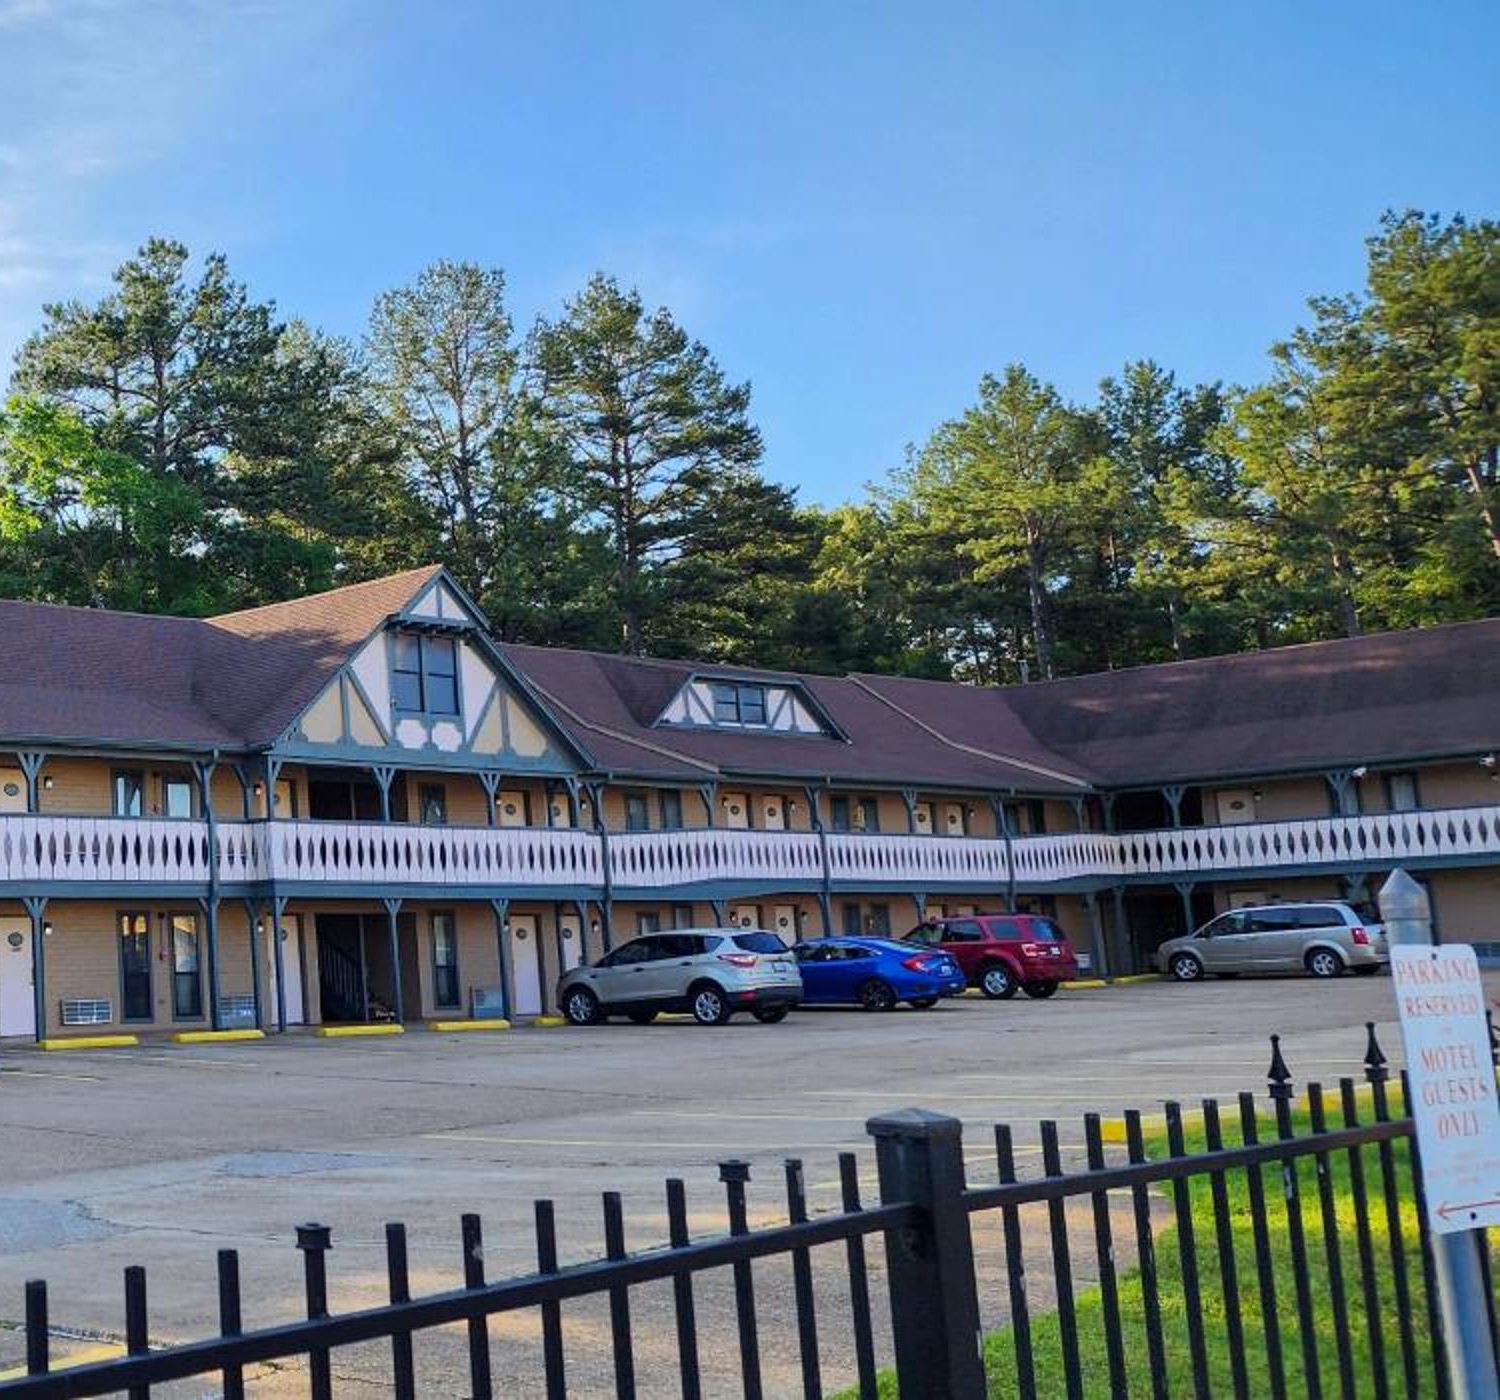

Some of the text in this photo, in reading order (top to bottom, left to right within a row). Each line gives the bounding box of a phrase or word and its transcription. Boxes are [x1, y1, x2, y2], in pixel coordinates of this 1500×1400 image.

[1395, 959, 1477, 984] PARKING
[1405, 994, 1477, 1018] RESERVED
[1421, 1045, 1478, 1072] MOTEL
[1422, 1076, 1488, 1107] GUESTS
[1437, 1111, 1480, 1138] ONLY
